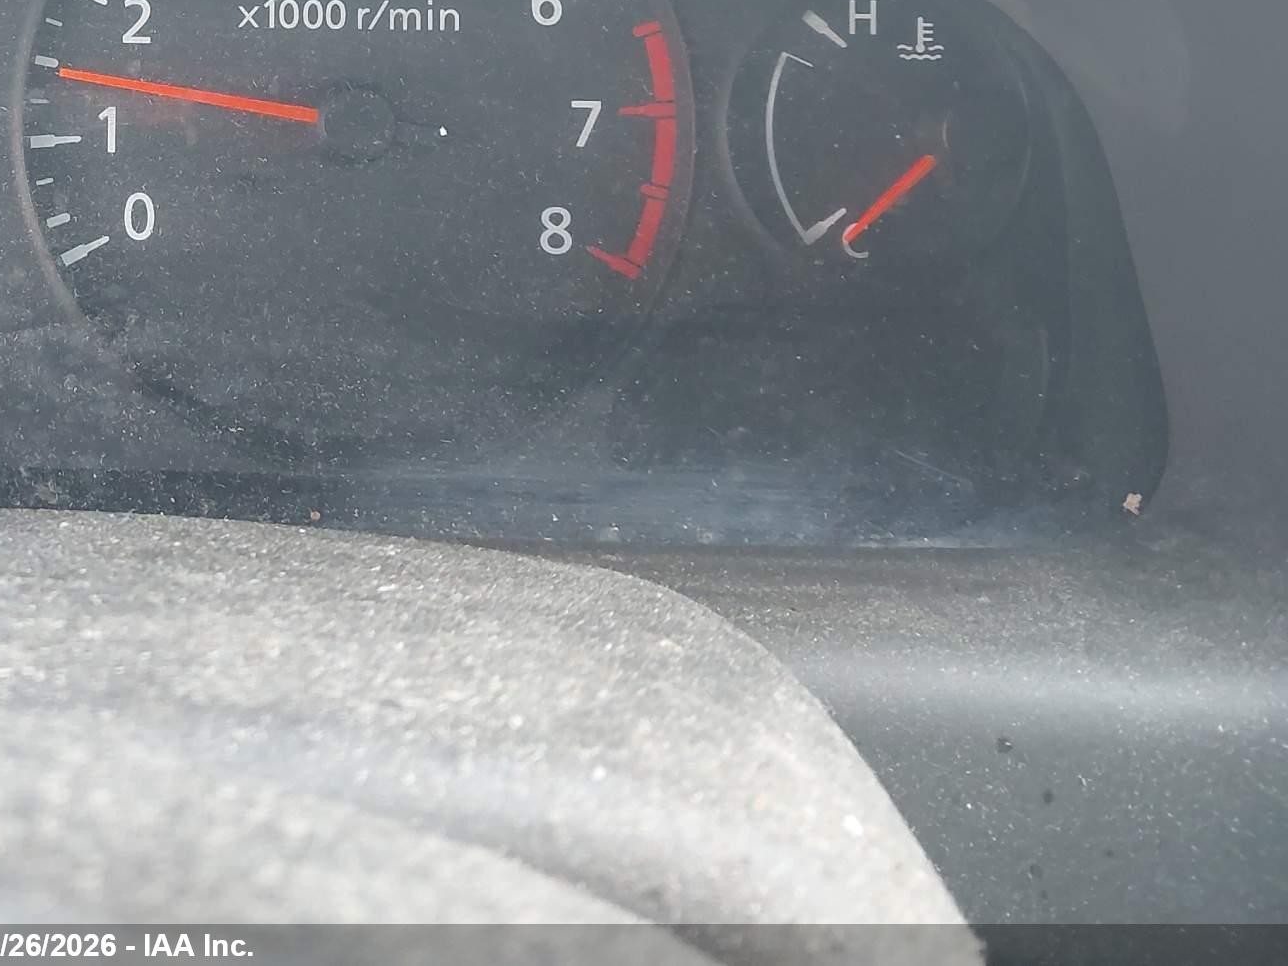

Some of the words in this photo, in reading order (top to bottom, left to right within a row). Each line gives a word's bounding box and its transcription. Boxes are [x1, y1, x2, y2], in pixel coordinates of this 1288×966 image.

[357, 0, 460, 32] r/min
[848, 0, 877, 35] H
[98, 106, 117, 154] 1
[571, 100, 602, 148] 7
[123, 192, 155, 241] 0
[539, 206, 573, 255] 8
[842, 223, 869, 258] C
